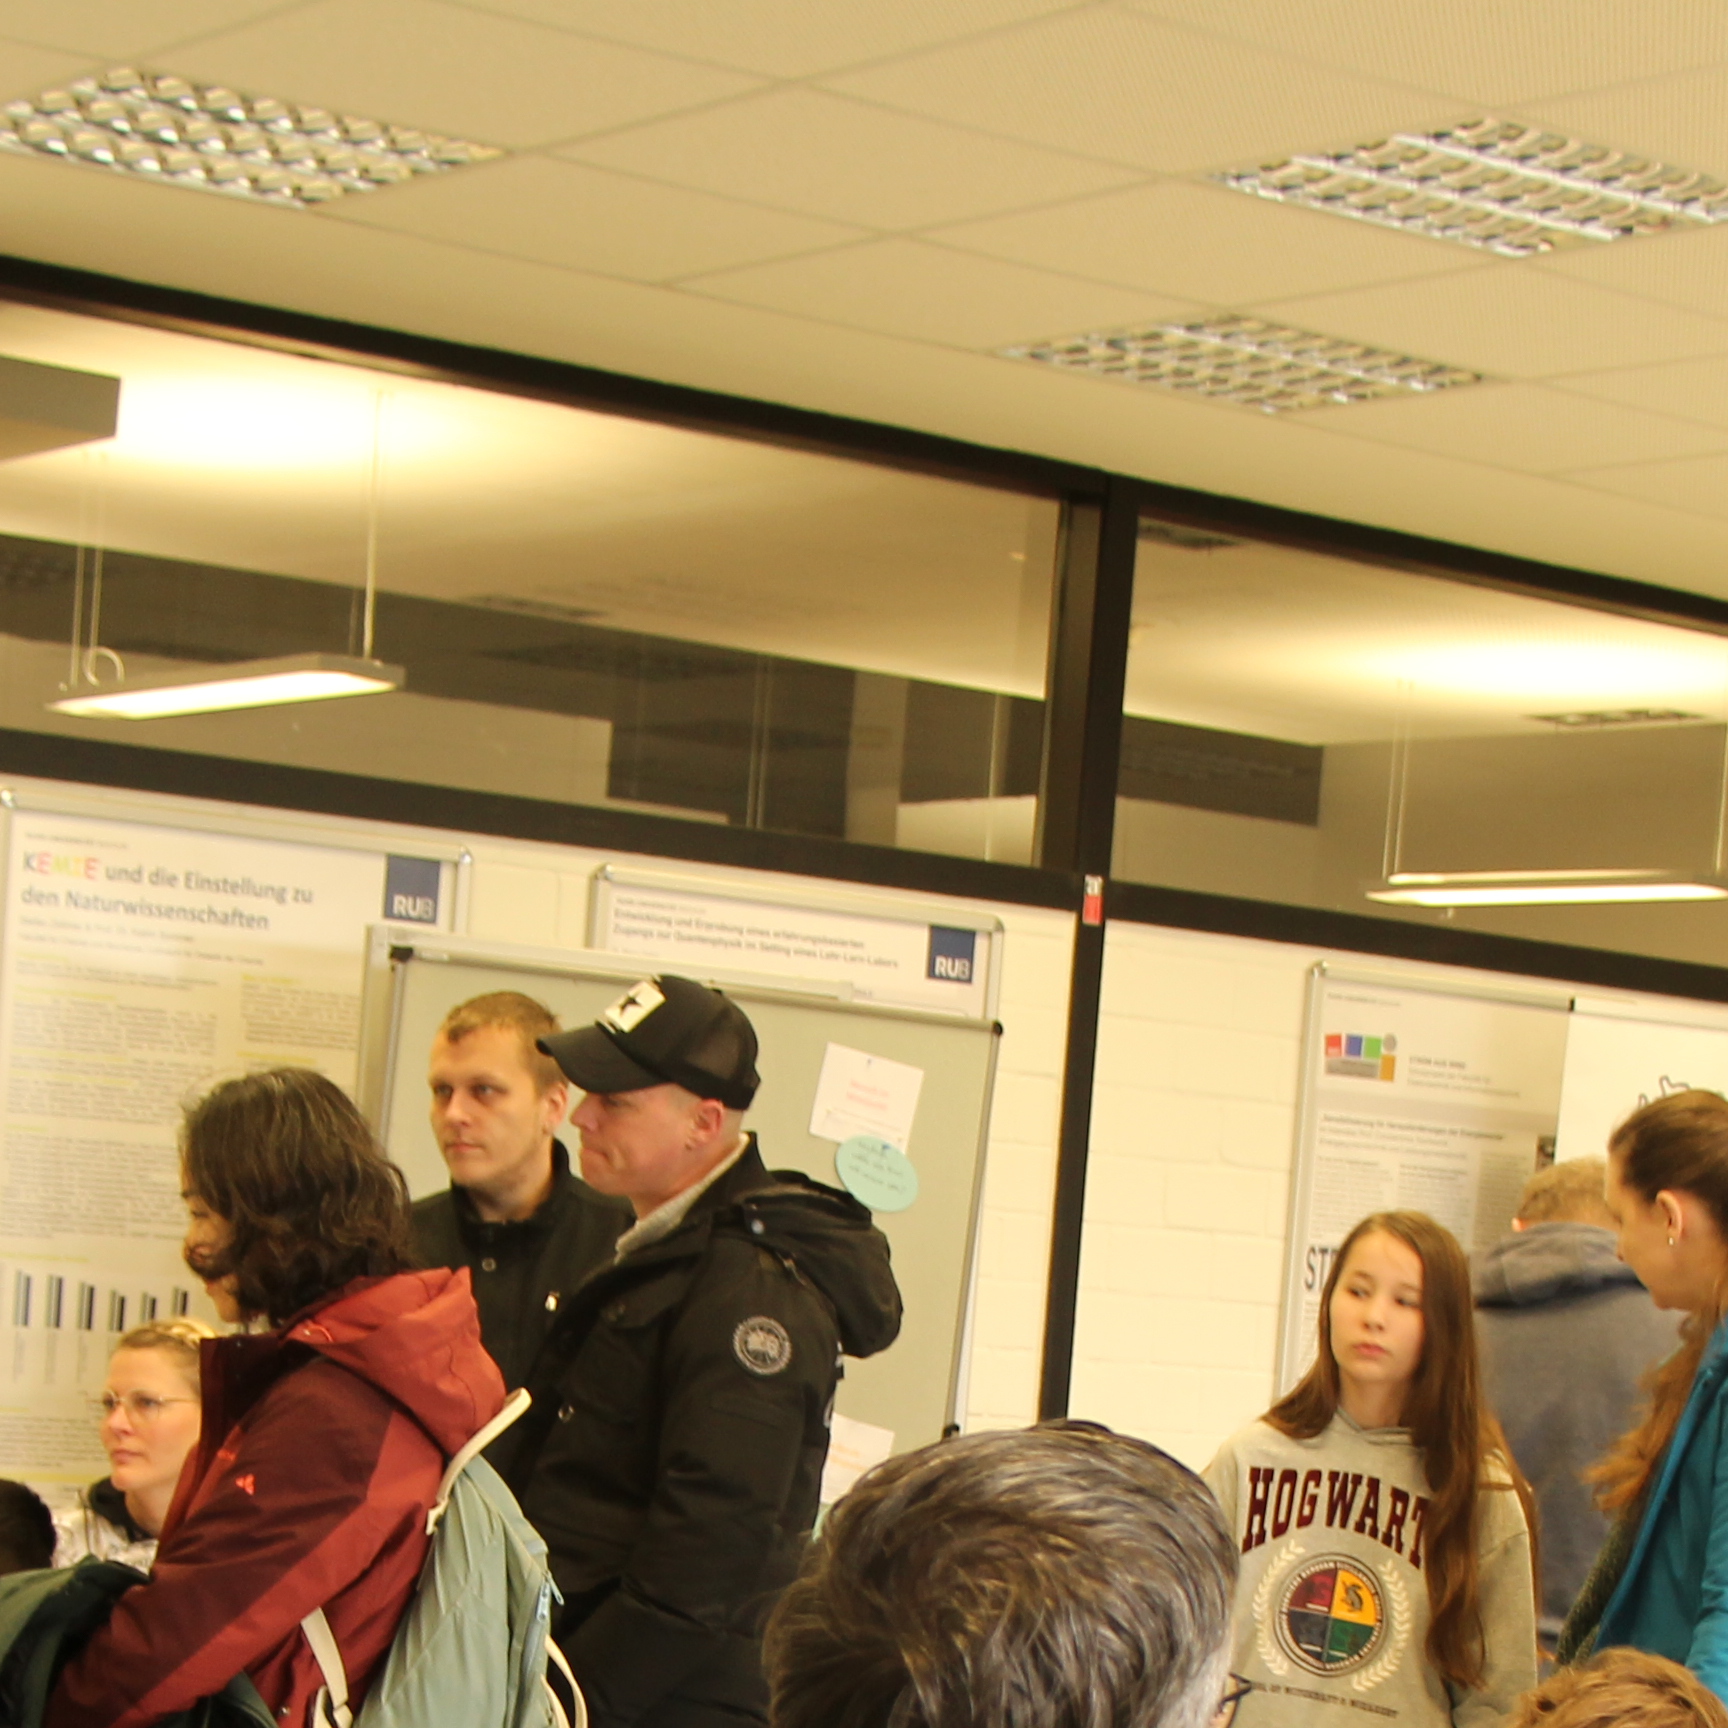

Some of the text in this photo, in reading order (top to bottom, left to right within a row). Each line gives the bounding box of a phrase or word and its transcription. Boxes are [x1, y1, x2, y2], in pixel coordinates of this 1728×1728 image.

[105, 865, 142, 884] und
[148, 866, 178, 888] die
[184, 869, 288, 905] Einstellung
[292, 886, 314, 904] zu
[21, 883, 60, 906] den
[64, 890, 270, 930] Naturwissenschaften
[393, 894, 436, 919] RUB
[934, 955, 970, 981] RUB
[1242, 1466, 1431, 1570] HOGWART
